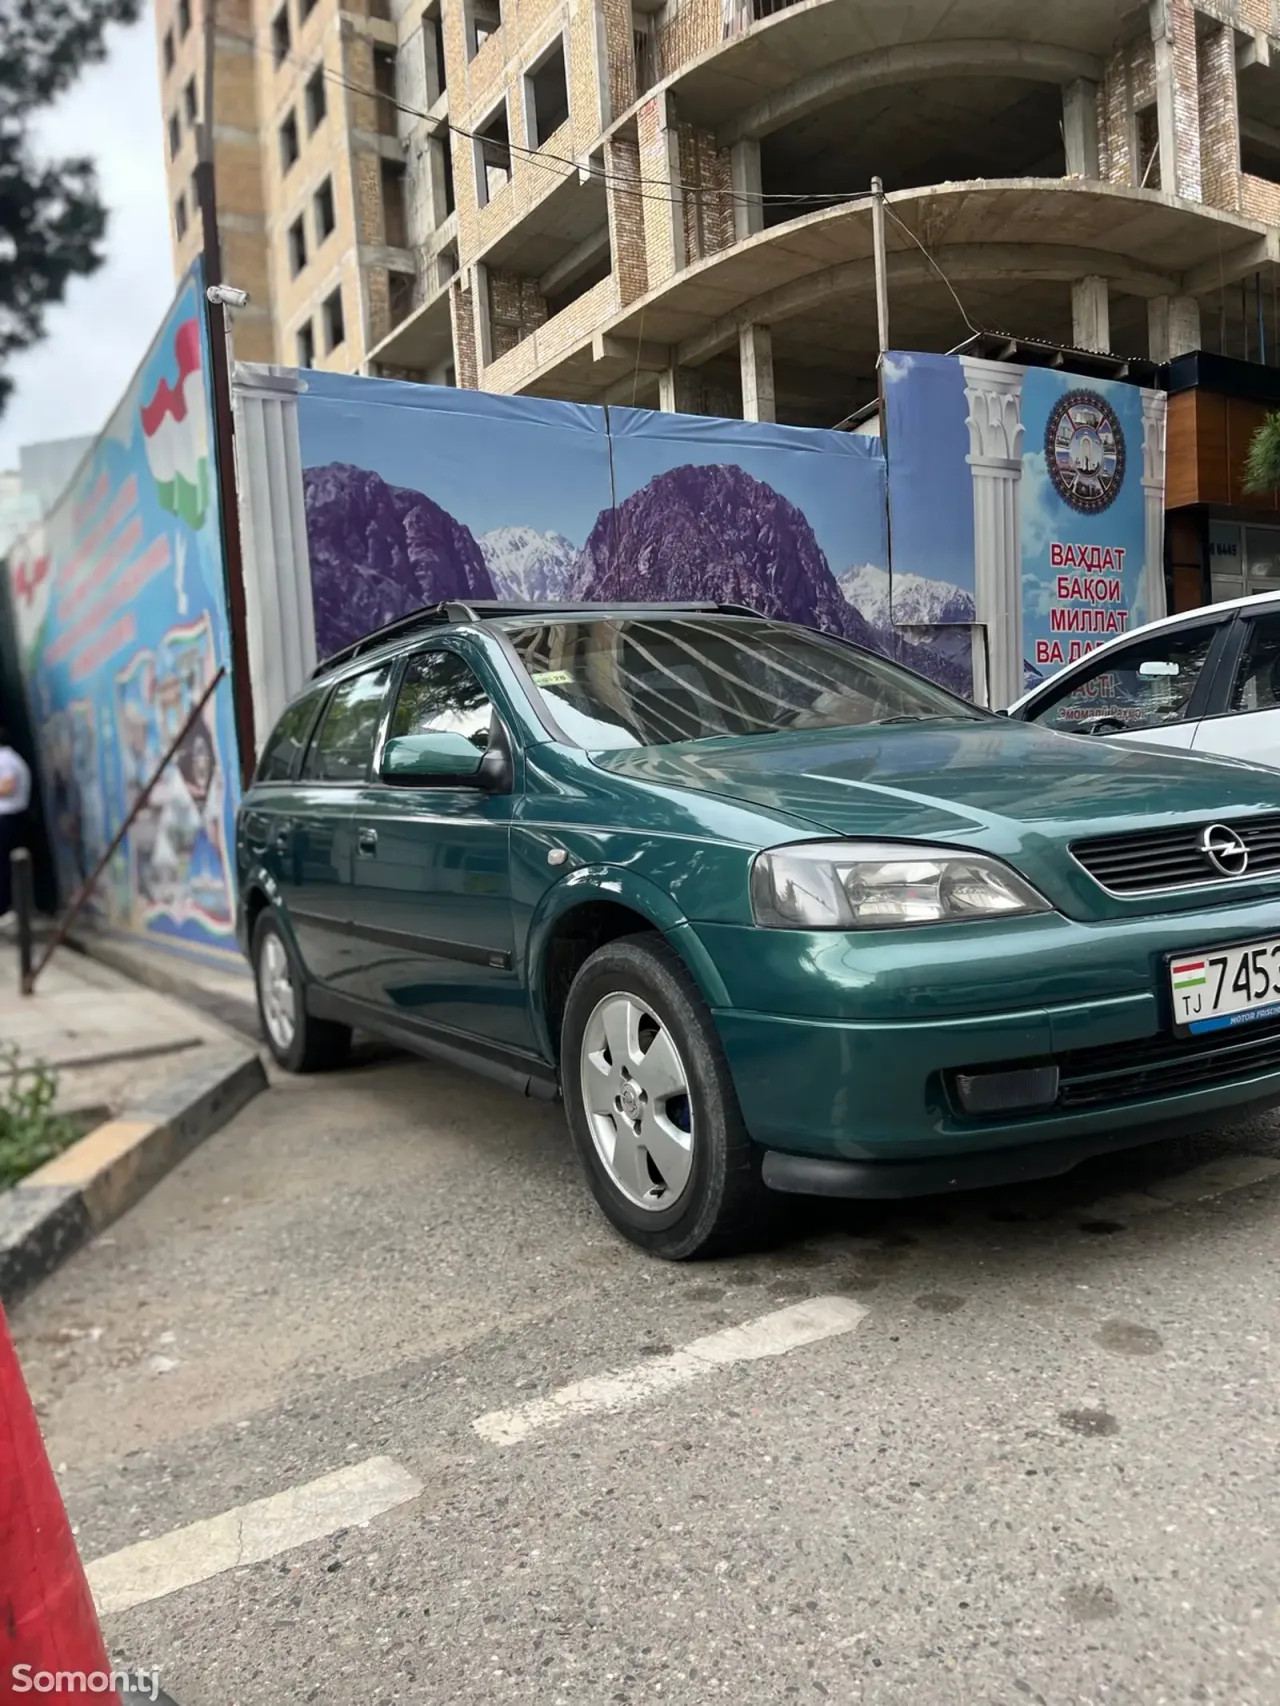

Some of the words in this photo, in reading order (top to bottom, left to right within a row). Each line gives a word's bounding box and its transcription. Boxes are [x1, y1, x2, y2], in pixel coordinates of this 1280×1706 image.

[1051, 608, 1127, 632] МИЛЛАТ
[1036, 641, 1063, 663] ВА
[1182, 994, 1201, 1015] TJ
[1230, 1012, 1255, 1024] MOTOR
